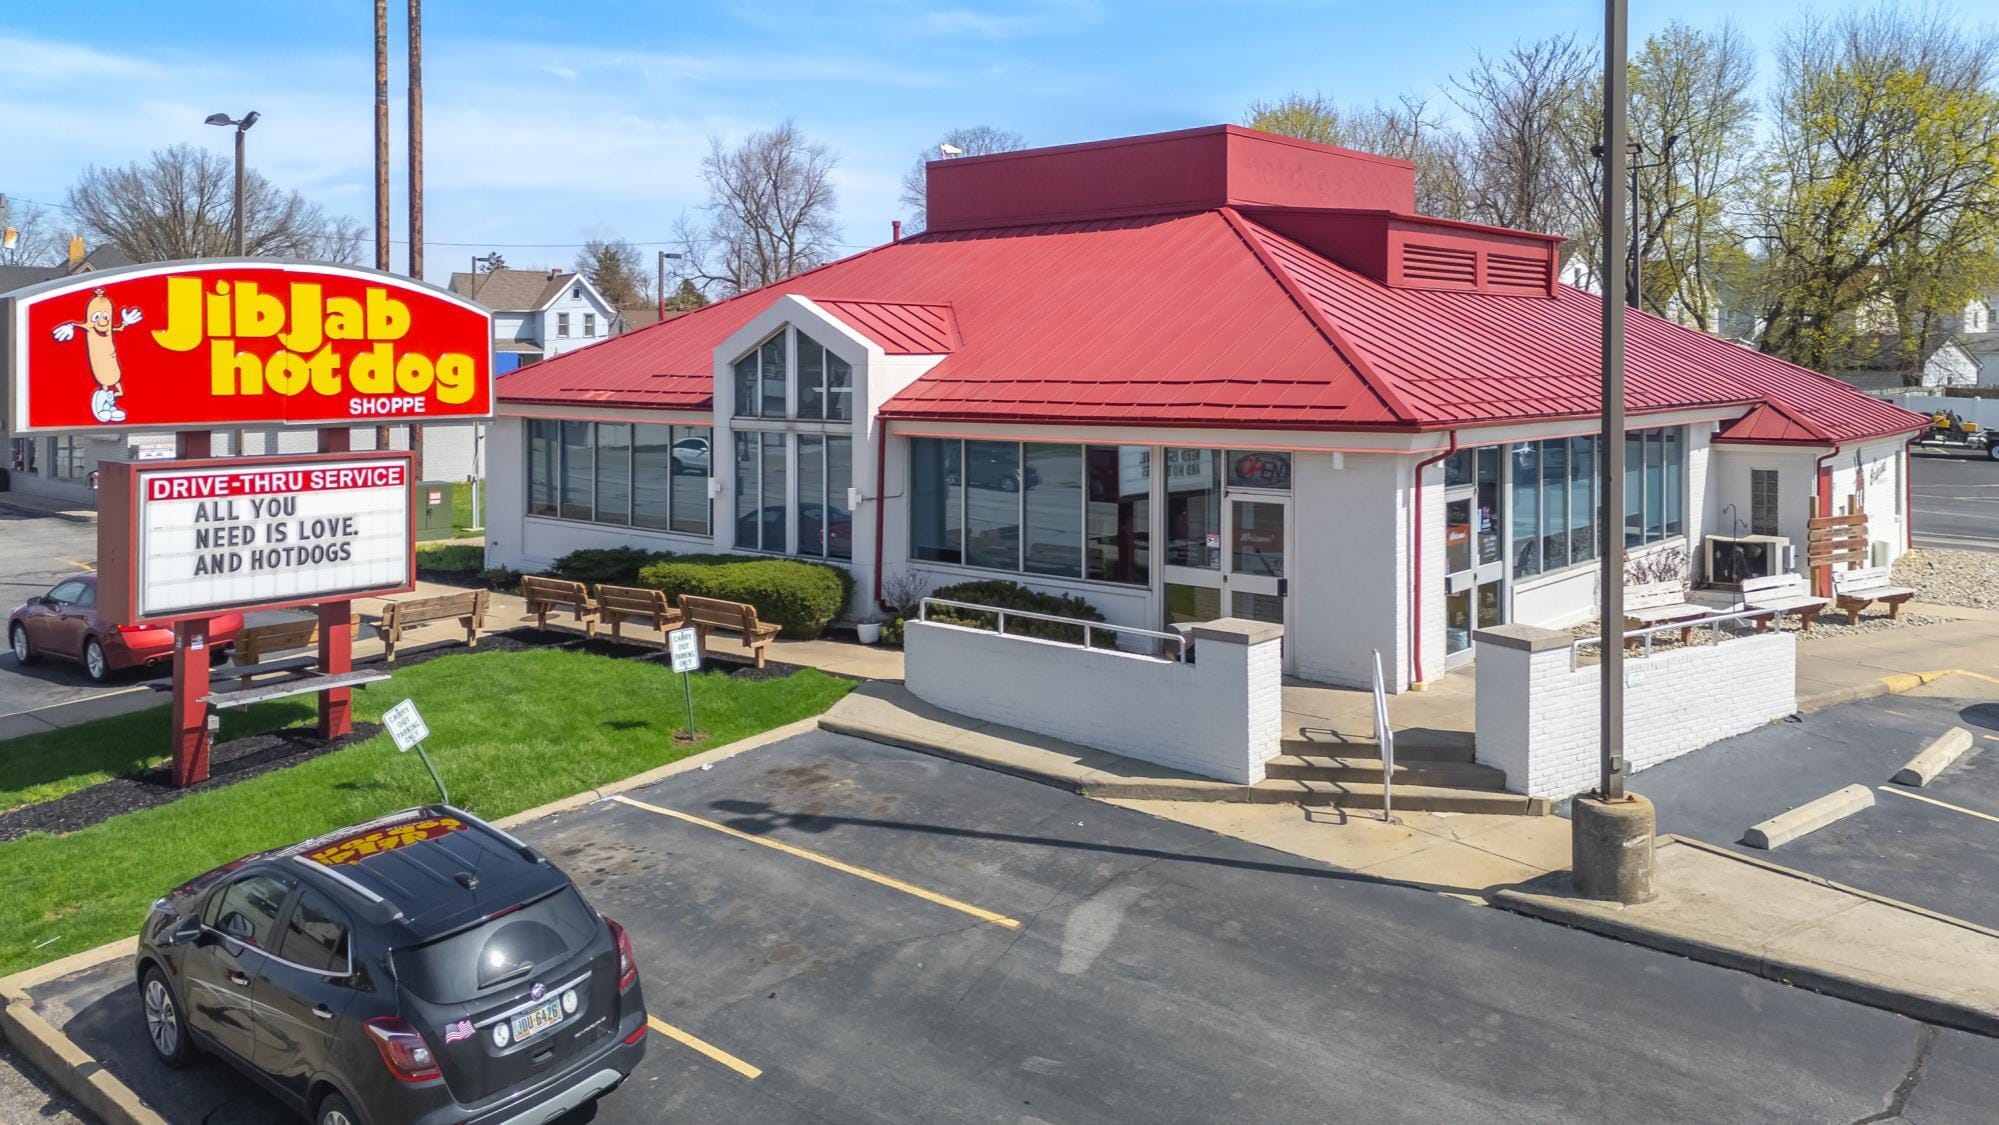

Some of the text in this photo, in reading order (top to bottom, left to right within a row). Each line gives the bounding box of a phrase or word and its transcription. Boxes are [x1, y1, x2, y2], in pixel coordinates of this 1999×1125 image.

[349, 396, 426, 415] SHOPPE
[153, 467, 401, 499] DRIVE-THRU SERVICE
[194, 496, 297, 523] ALL YOU
[196, 516, 359, 550] NEED IS LOVE.
[194, 541, 352, 577] AND HOTDOGS
[674, 651, 695, 660] PARKING
[390, 706, 409, 723] CARRY
[396, 721, 420, 739] PARKING
